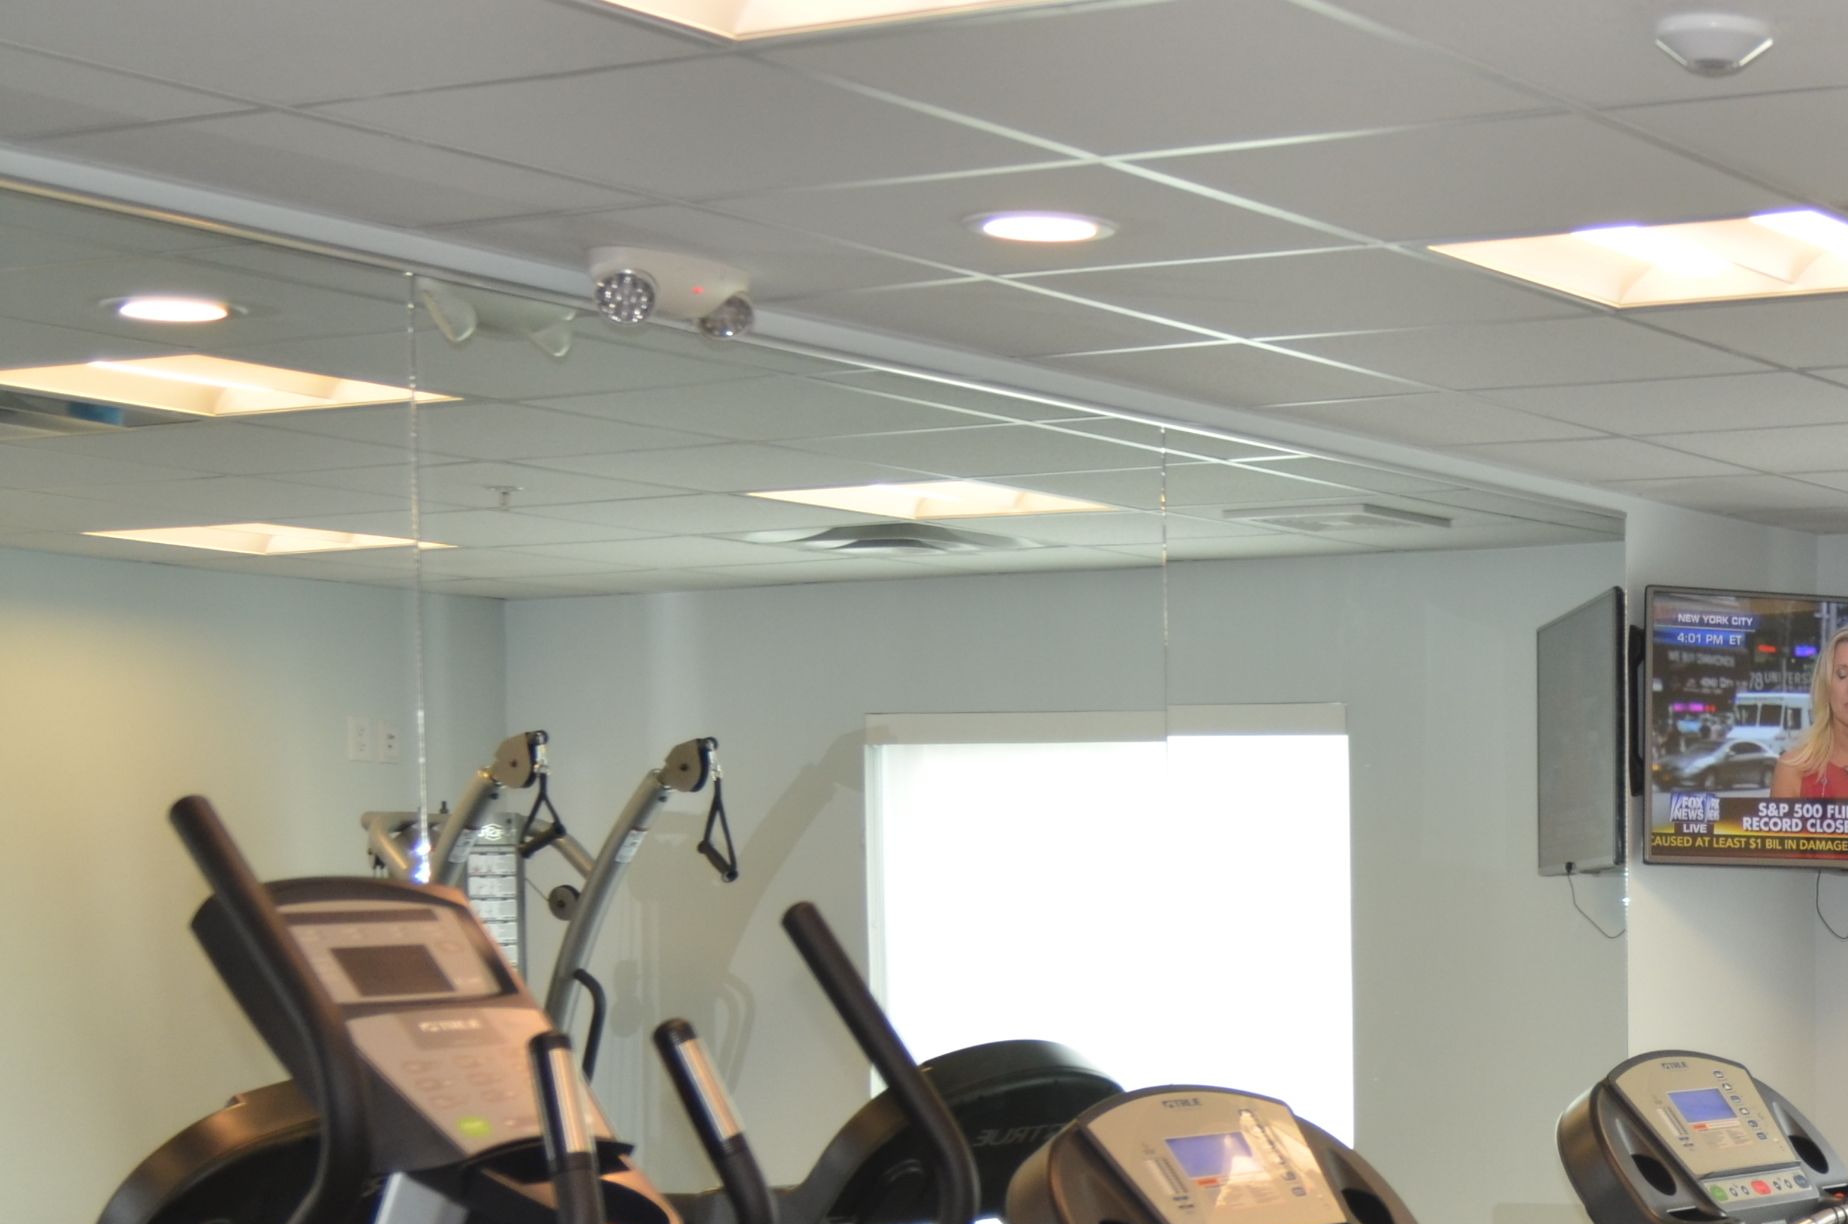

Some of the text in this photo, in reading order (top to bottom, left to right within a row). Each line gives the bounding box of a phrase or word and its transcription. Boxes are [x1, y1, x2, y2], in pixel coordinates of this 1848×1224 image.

[1677, 613, 1754, 626] NEW YORK CITY
[1677, 633, 1743, 646] 4:01 PM ET
[1681, 796, 1704, 809] FOX
[1674, 808, 1704, 821] NEWS
[1758, 802, 1789, 817] S&P
[1793, 803, 1823, 819] 500
[1682, 823, 1708, 834] LIVE
[1742, 816, 1803, 833] RECORD
[1695, 836, 1712, 848] AT
[1713, 837, 1747, 849] LEAST
[1765, 839, 1782, 850] BIL
[1784, 840, 1797, 851] IN
[1799, 840, 1848, 852] DAMAGE
